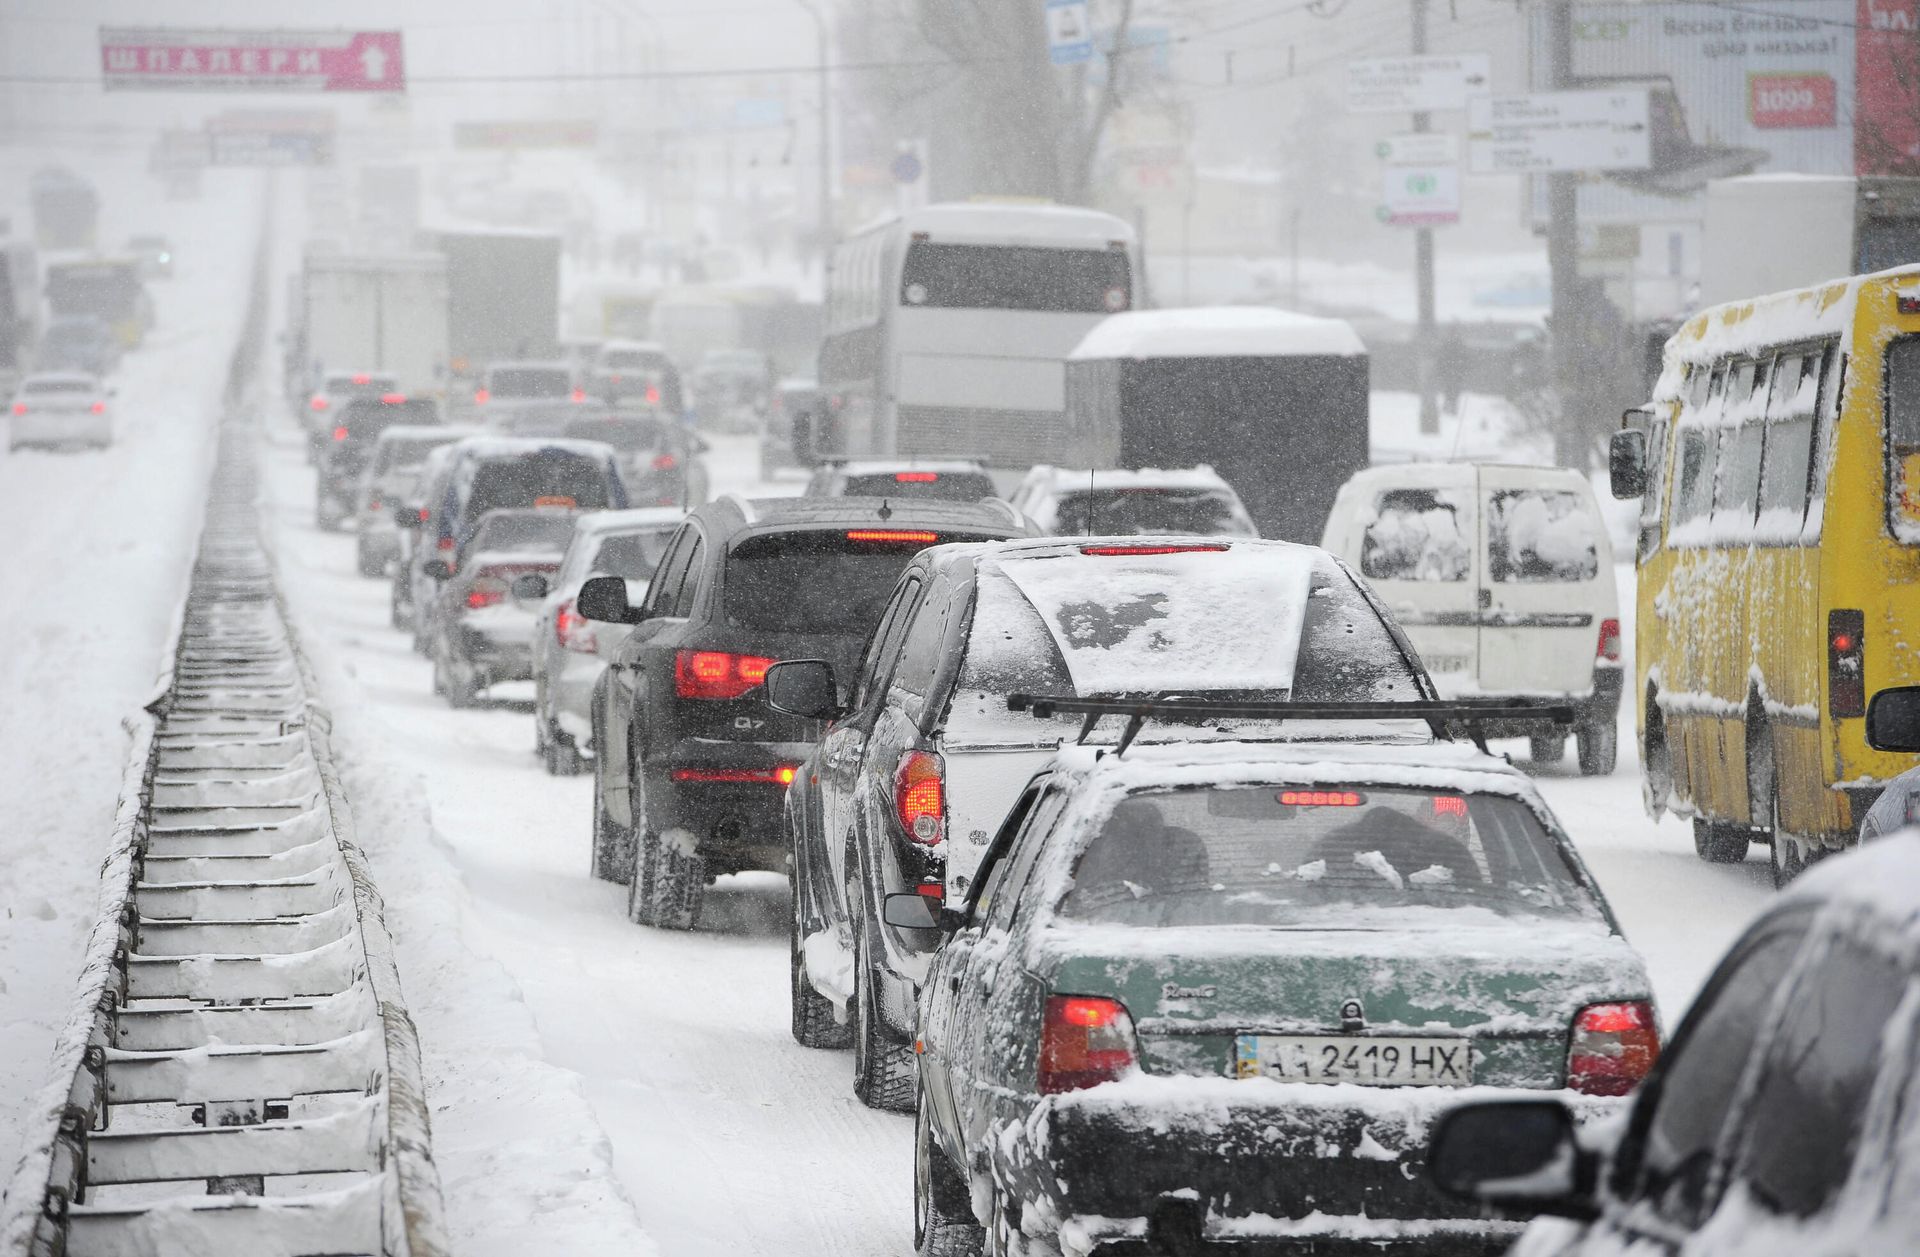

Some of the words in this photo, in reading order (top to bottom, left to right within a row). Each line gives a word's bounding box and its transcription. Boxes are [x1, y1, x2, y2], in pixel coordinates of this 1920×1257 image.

[108, 48, 321, 71] ШПАЛЕРИ
[735, 716, 764, 729] Q7
[1321, 1044, 1400, 1078] 2419
[1410, 1046, 1460, 1079] HX
